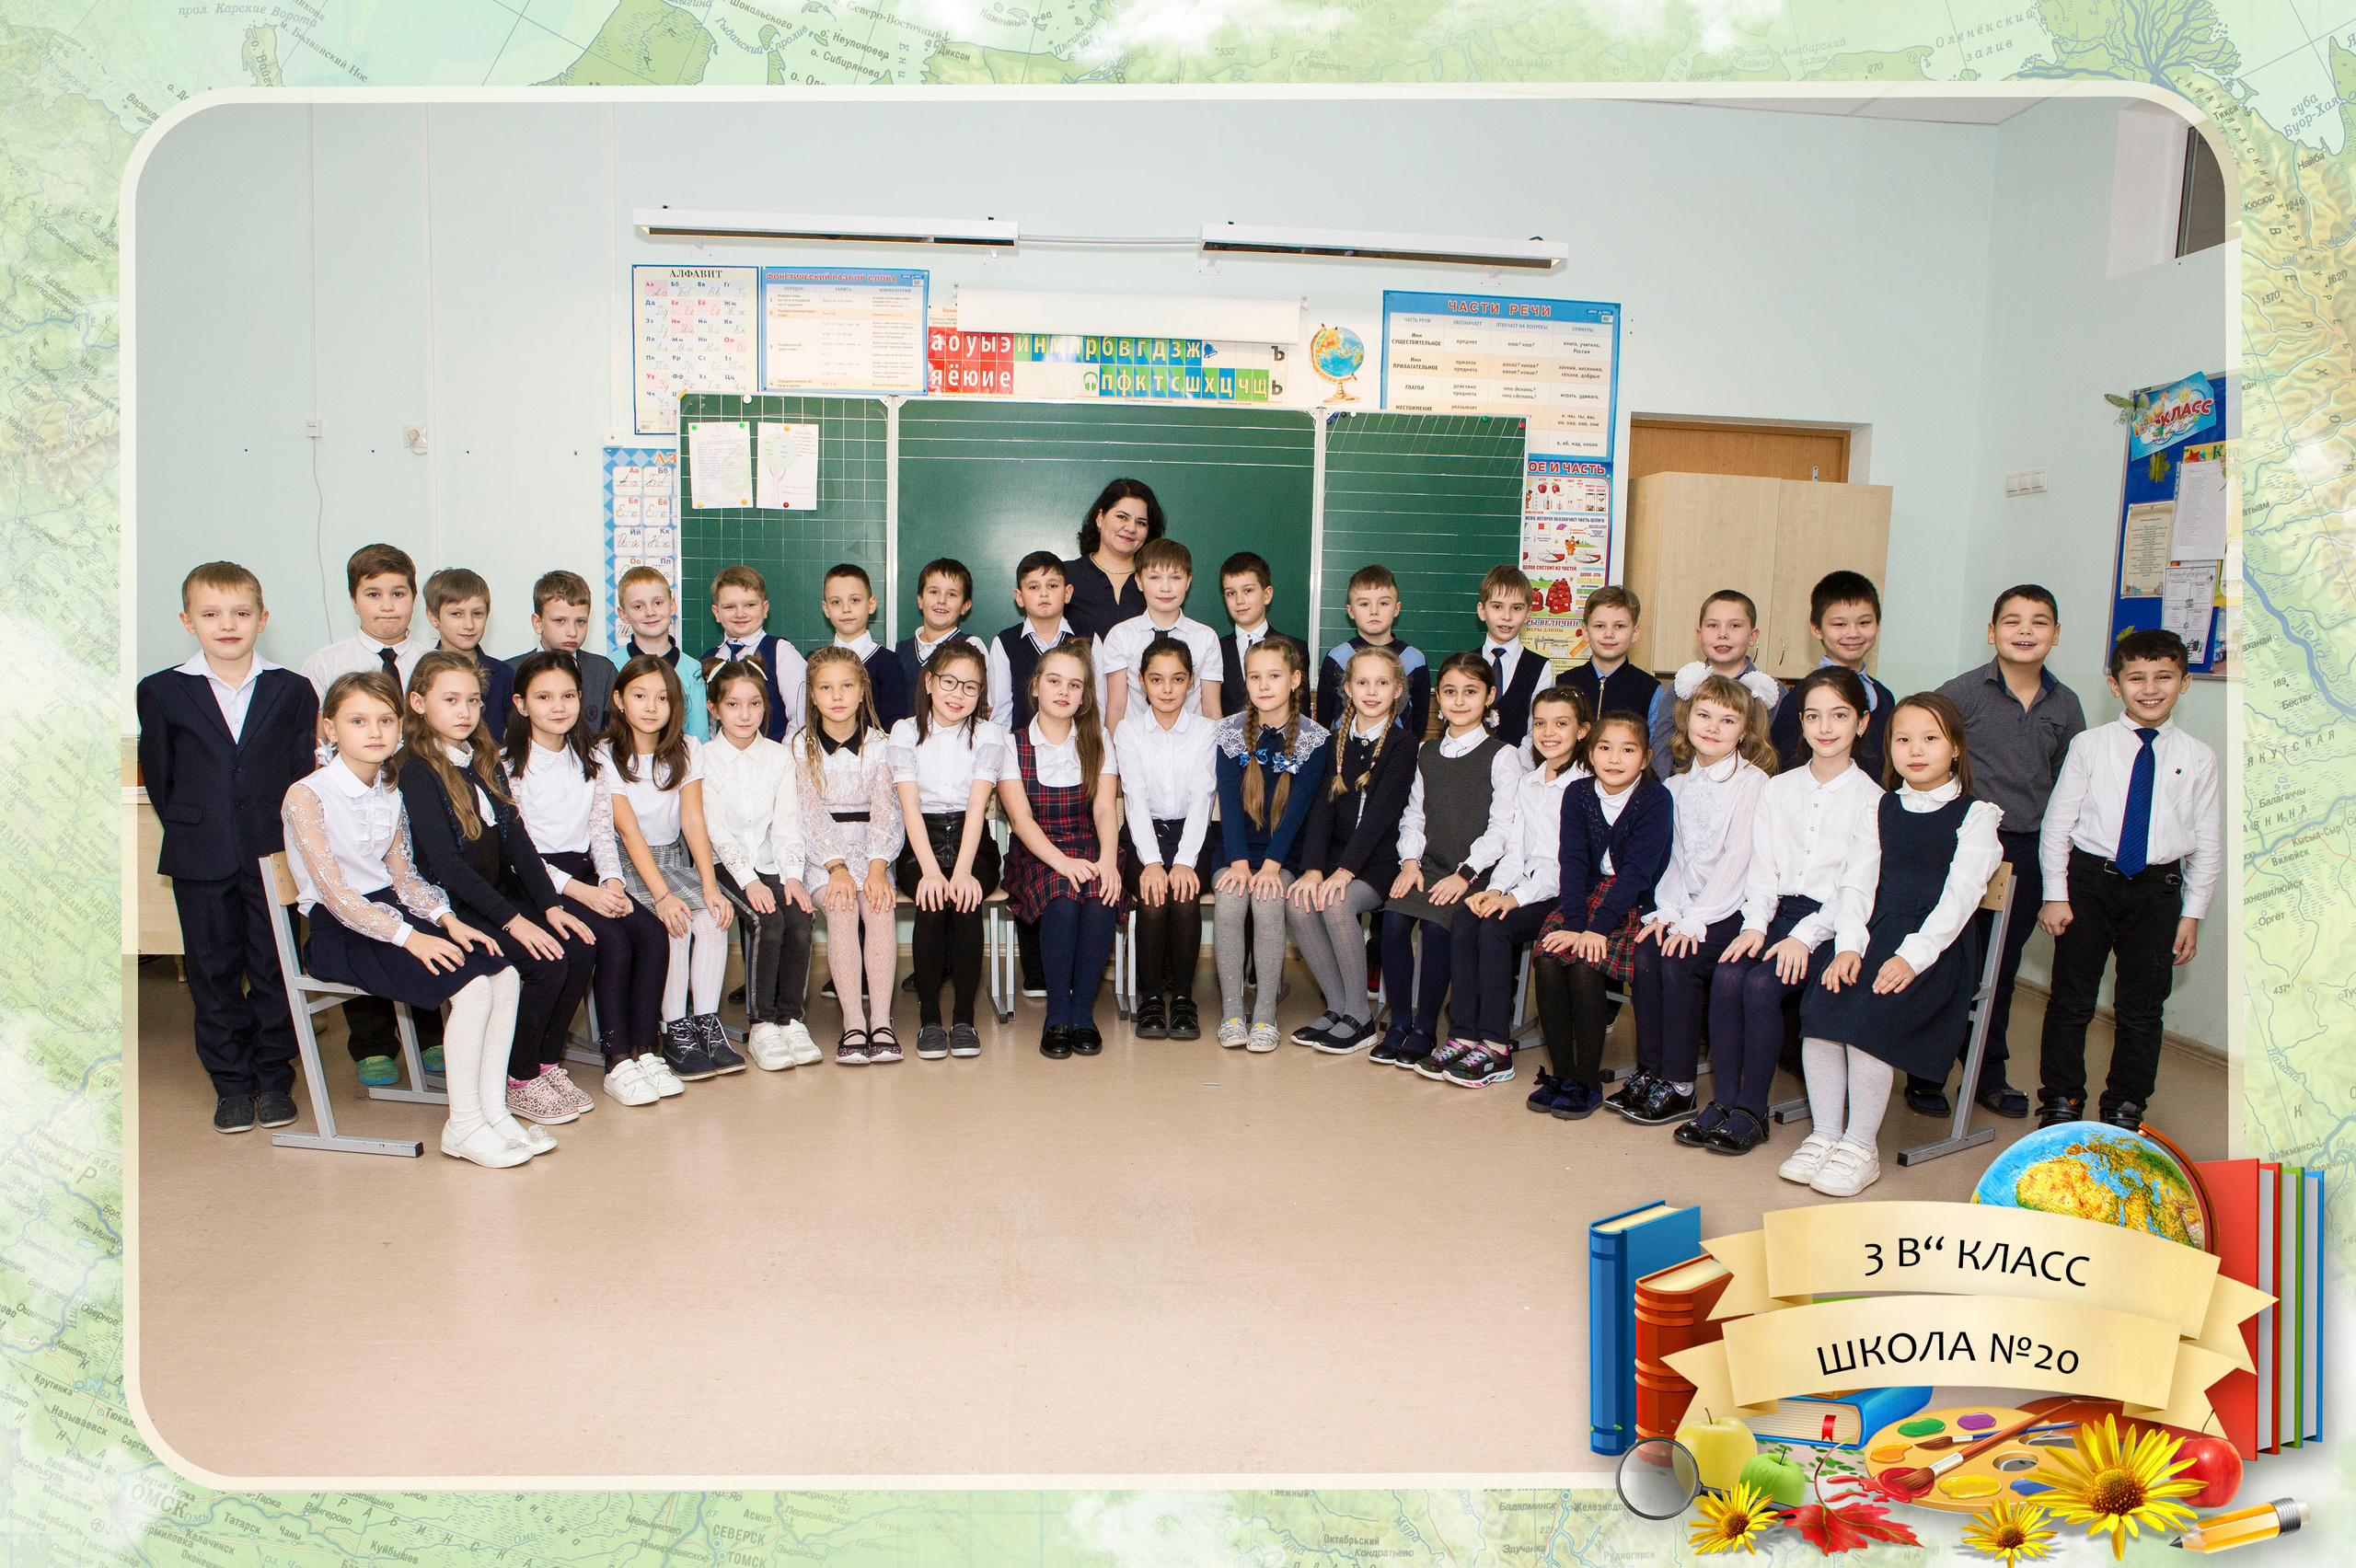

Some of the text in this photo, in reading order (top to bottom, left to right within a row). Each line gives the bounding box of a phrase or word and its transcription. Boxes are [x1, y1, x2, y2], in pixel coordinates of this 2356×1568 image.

[669, 269, 723, 280] АЛФАВИТ
[766, 273, 897, 283] ФОНЕТИЧЕСКИЙ РАЗБОР СЛОВА
[1449, 300, 1552, 317] ЧАСТИ РЕЧИ
[2160, 399, 2213, 427] КЛАСС
[1550, 462, 1559, 473] И
[1563, 463, 1605, 475] ЧАСТЬ
